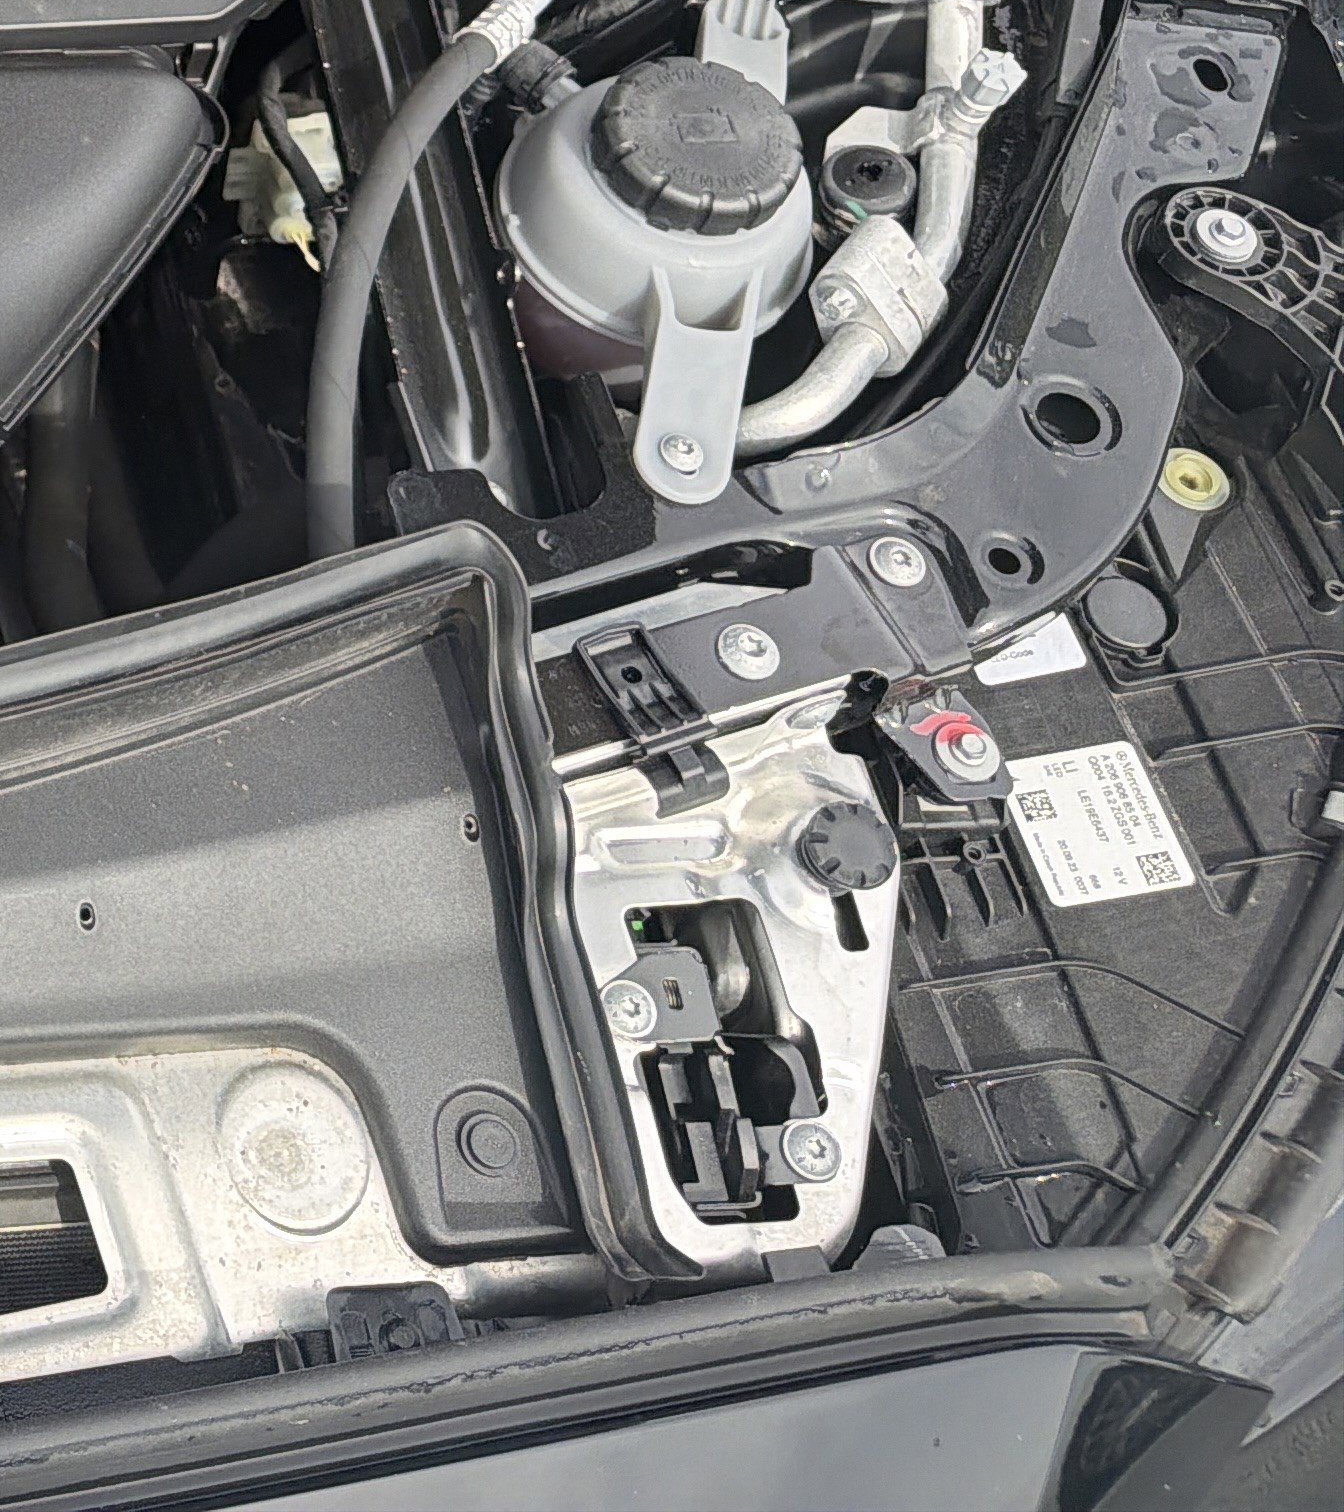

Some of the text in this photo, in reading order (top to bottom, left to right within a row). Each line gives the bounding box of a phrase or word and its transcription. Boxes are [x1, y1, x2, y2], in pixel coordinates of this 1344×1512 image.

[1099, 754, 1111, 762] A
[1104, 762, 1120, 781] 206
[1119, 761, 1163, 839] Mercedes-Benz
[1120, 827, 1136, 845] 001
